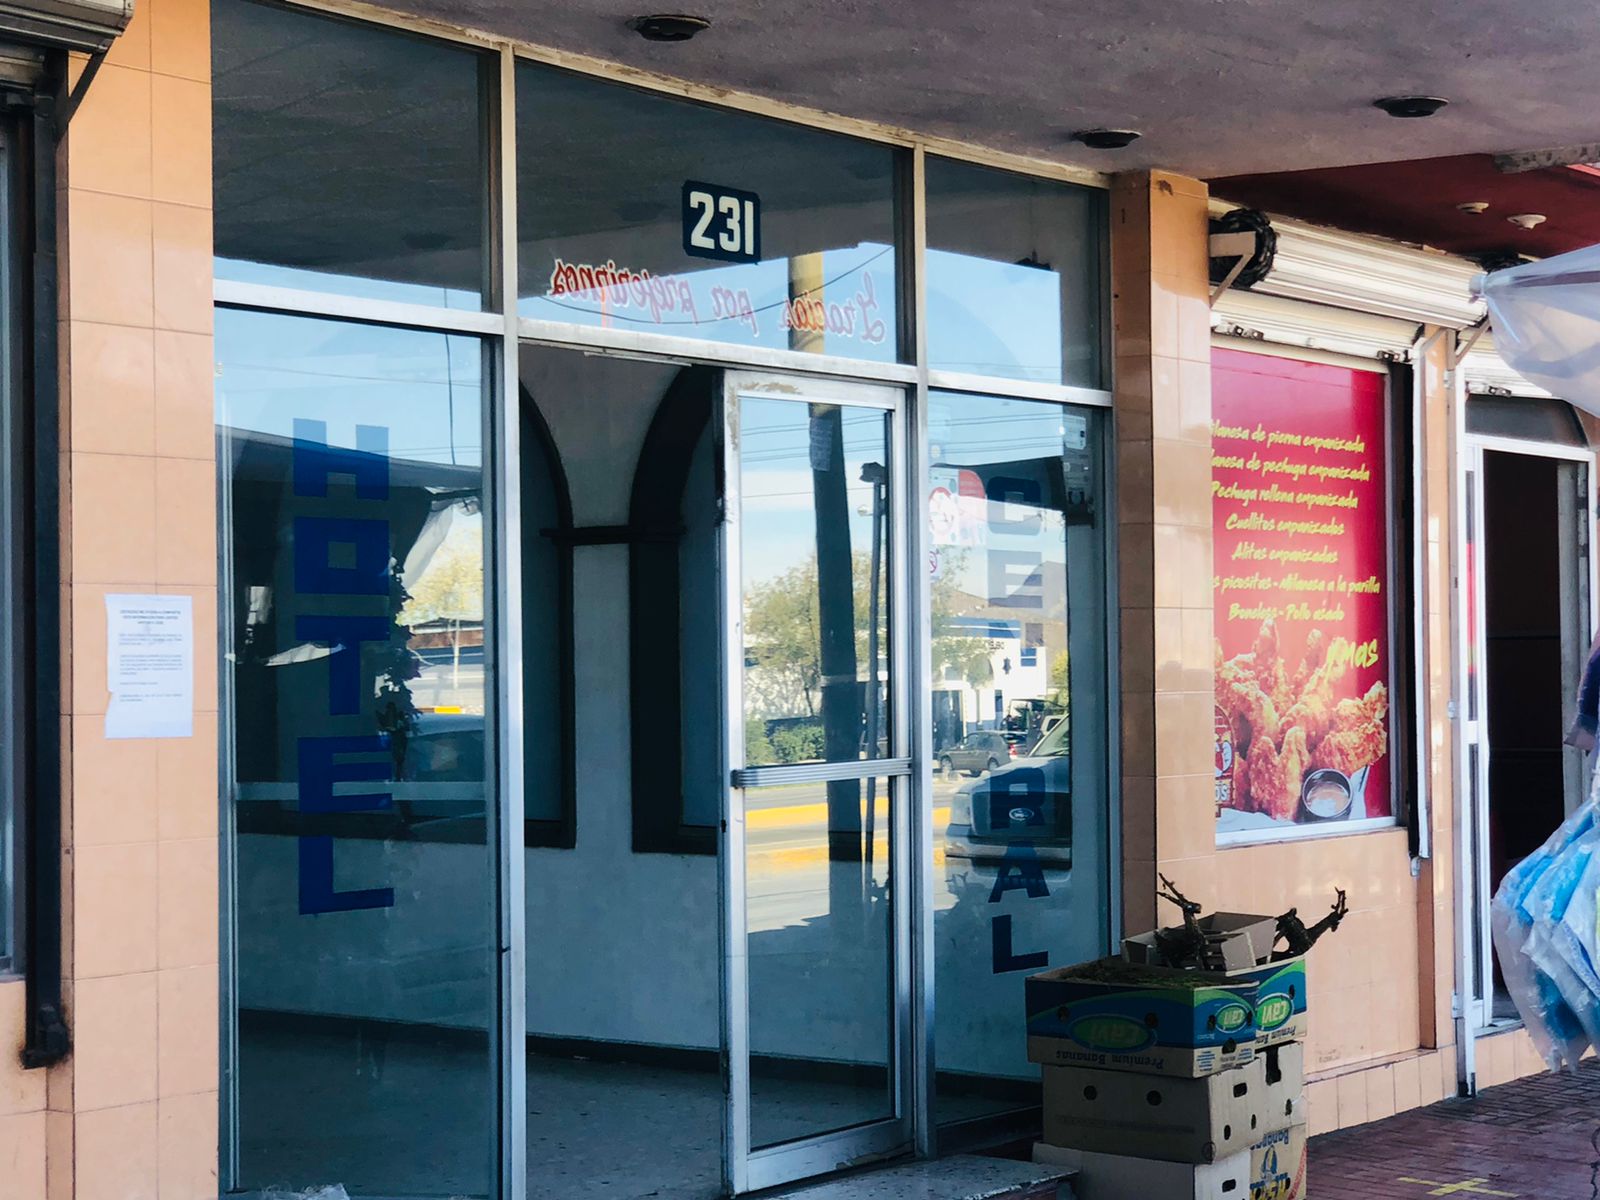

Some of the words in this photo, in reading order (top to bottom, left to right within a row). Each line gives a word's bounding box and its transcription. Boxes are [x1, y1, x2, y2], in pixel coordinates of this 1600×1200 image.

[690, 191, 754, 256] 231
[1251, 423, 1266, 444] de
[1266, 430, 1301, 448] pierna
[1246, 452, 1262, 472] de
[1261, 457, 1307, 481] pechuga
[1210, 481, 1257, 507] Pechuga
[292, 418, 394, 915] HOTEL
[986, 475, 1050, 974] CERAL
[1056, 1050, 1106, 1066] Bananas
[1112, 1054, 1164, 1070] Premium
